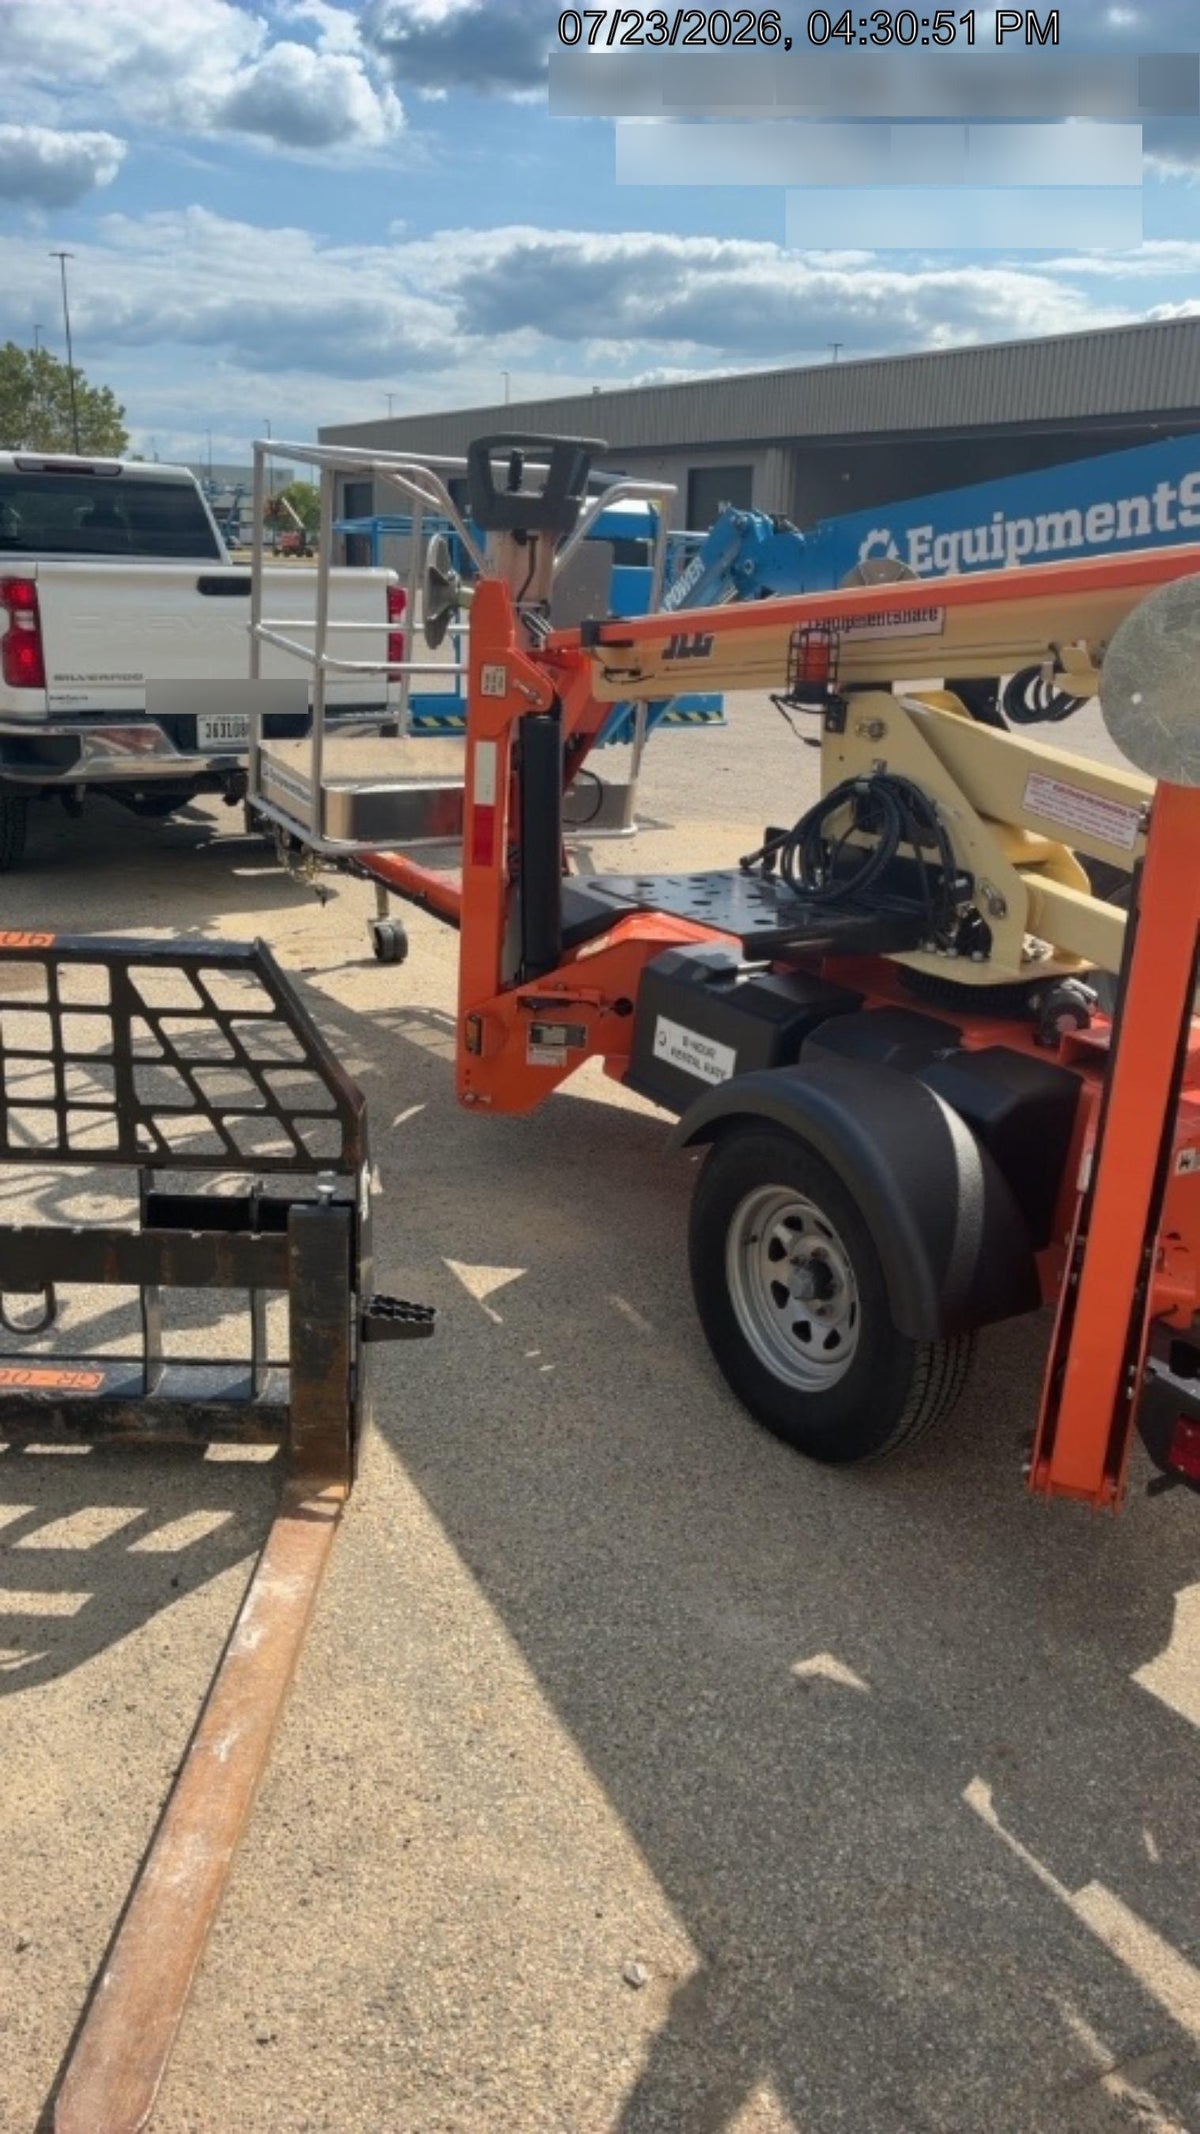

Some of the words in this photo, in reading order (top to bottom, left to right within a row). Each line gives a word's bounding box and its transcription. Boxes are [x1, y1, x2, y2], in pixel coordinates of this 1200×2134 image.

[905, 471, 1200, 576] EquipmentS
[661, 632, 715, 659] JLG
[54, 672, 143, 682] SILVERADO
